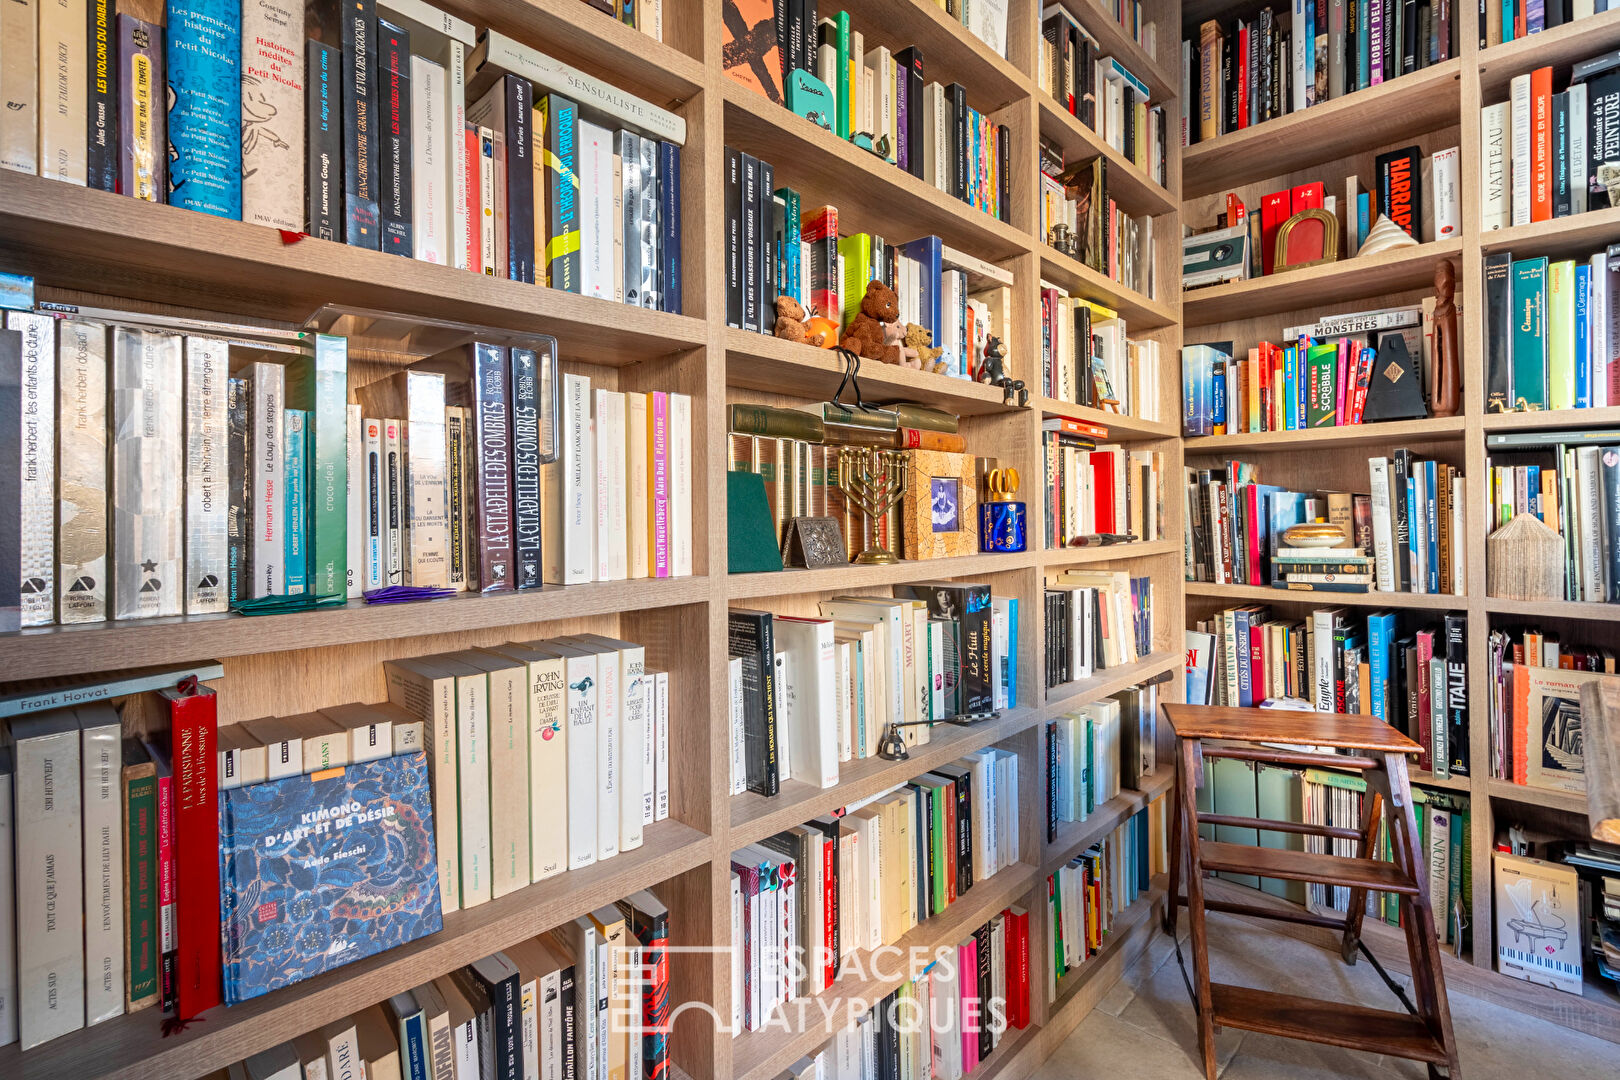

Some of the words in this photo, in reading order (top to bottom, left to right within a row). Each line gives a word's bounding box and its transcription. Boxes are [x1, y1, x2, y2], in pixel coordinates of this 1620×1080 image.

[172, 7, 188, 17] Les
[190, 10, 236, 34] premières
[184, 20, 226, 40] histoires
[97, 28, 106, 41] DU
[199, 35, 212, 45] du
[1371, 26, 1381, 65] ROBERT
[175, 39, 202, 54] Petit
[204, 46, 234, 66] Nicolas
[256, 37, 295, 57] Histoires
[259, 48, 292, 66] inédites
[97, 42, 107, 79] VIOLONS
[270, 62, 282, 72] du
[389, 52, 399, 88] POURPRES
[791, 61, 796, 70] LA
[97, 80, 107, 93] LES
[248, 66, 271, 80] Petit
[272, 72, 302, 91] Nicolas
[320, 73, 328, 81] du
[799, 77, 824, 97] Vespa
[389, 90, 400, 122] RIVIÈRES
[568, 76, 644, 117] SENSUALISTE
[97, 102, 106, 128] Grasset
[321, 101, 330, 121] degré
[1593, 106, 1602, 115] de
[391, 123, 400, 135] LES
[558, 109, 573, 155] PERROQUET
[1537, 121, 1545, 129] EN
[1606, 92, 1619, 158] PEINTURE
[97, 129, 106, 146] Jules
[1593, 117, 1603, 160] dictionnaire
[559, 156, 573, 169] DU
[1571, 136, 1582, 166] DÉTAIL
[321, 154, 330, 179] Gough
[1488, 128, 1503, 202] WATTEAU
[1537, 162, 1545, 171] LA
[1573, 168, 1582, 178] LE
[321, 182, 329, 215] Laurence
[558, 170, 574, 211] THÉORÈME
[560, 212, 574, 223] LE
[563, 256, 572, 289] DENIS
[1578, 275, 1587, 308] Céramique
[1521, 298, 1534, 332] Céramique
[26, 324, 37, 348] dune
[1314, 320, 1378, 337] MONSTRES
[26, 351, 37, 363] de
[25, 366, 37, 399] enfants
[485, 369, 494, 395] ROBIN
[493, 370, 502, 394] HOBB
[518, 375, 526, 400] ROBIN
[525, 376, 534, 399] HOBB
[1321, 363, 1331, 411] SCRABBLE
[25, 402, 37, 414] les
[266, 394, 274, 423] steppes
[265, 425, 273, 438] des
[483, 401, 506, 448] OMBRES
[514, 407, 537, 452] OMBRES
[26, 422, 37, 456] herbert
[265, 441, 274, 461] Loup
[484, 450, 508, 471] DES
[25, 458, 37, 481] frank
[265, 463, 273, 472] Le
[516, 453, 538, 475] DES
[1046, 441, 1055, 487] TOLKIEN
[265, 480, 273, 502] Hesse
[324, 462, 334, 511] croco-deal
[486, 473, 509, 535] CITADELLE
[517, 476, 540, 535] CITADELLE
[265, 505, 273, 542] Hermann
[1397, 520, 1409, 544] PARIS
[487, 535, 509, 551] LA
[519, 536, 540, 551] LA
[905, 622, 913, 668] MOZART
[968, 631, 978, 658] Huit
[982, 620, 991, 651] magique
[1238, 630, 1247, 657] DÉSERT
[969, 662, 978, 676] Le
[1239, 658, 1248, 668] DU
[534, 680, 564, 694] IRVING
[536, 672, 560, 683] JOHN
[982, 674, 989, 682] Le
[1239, 670, 1249, 690] CITÉS
[1448, 663, 1466, 710] ITALIE
[20, 696, 60, 710] Frank
[64, 687, 108, 702] Horvat
[1318, 679, 1332, 710] Egypte
[1409, 691, 1417, 719] Venise
[44, 758, 54, 796] HUSTVEDT
[45, 797, 54, 811] SIRI
[301, 801, 361, 824] KIMONO
[266, 827, 312, 848] D'ART
[316, 819, 333, 836] ET
[336, 813, 354, 831] DE
[357, 802, 395, 827] DÉSIR
[1051, 822, 1057, 831] LA
[303, 854, 330, 870] Aude
[334, 844, 366, 864] Fieschi
[1433, 838, 1445, 880] JARDIN
[45, 854, 57, 884] J'AIMAIS
[46, 885, 57, 903] QUE
[162, 880, 171, 902] Eugène
[46, 904, 56, 913] CE
[47, 915, 56, 932] TOUT
[48, 972, 56, 987] SUD
[48, 988, 57, 1010] ACTES
